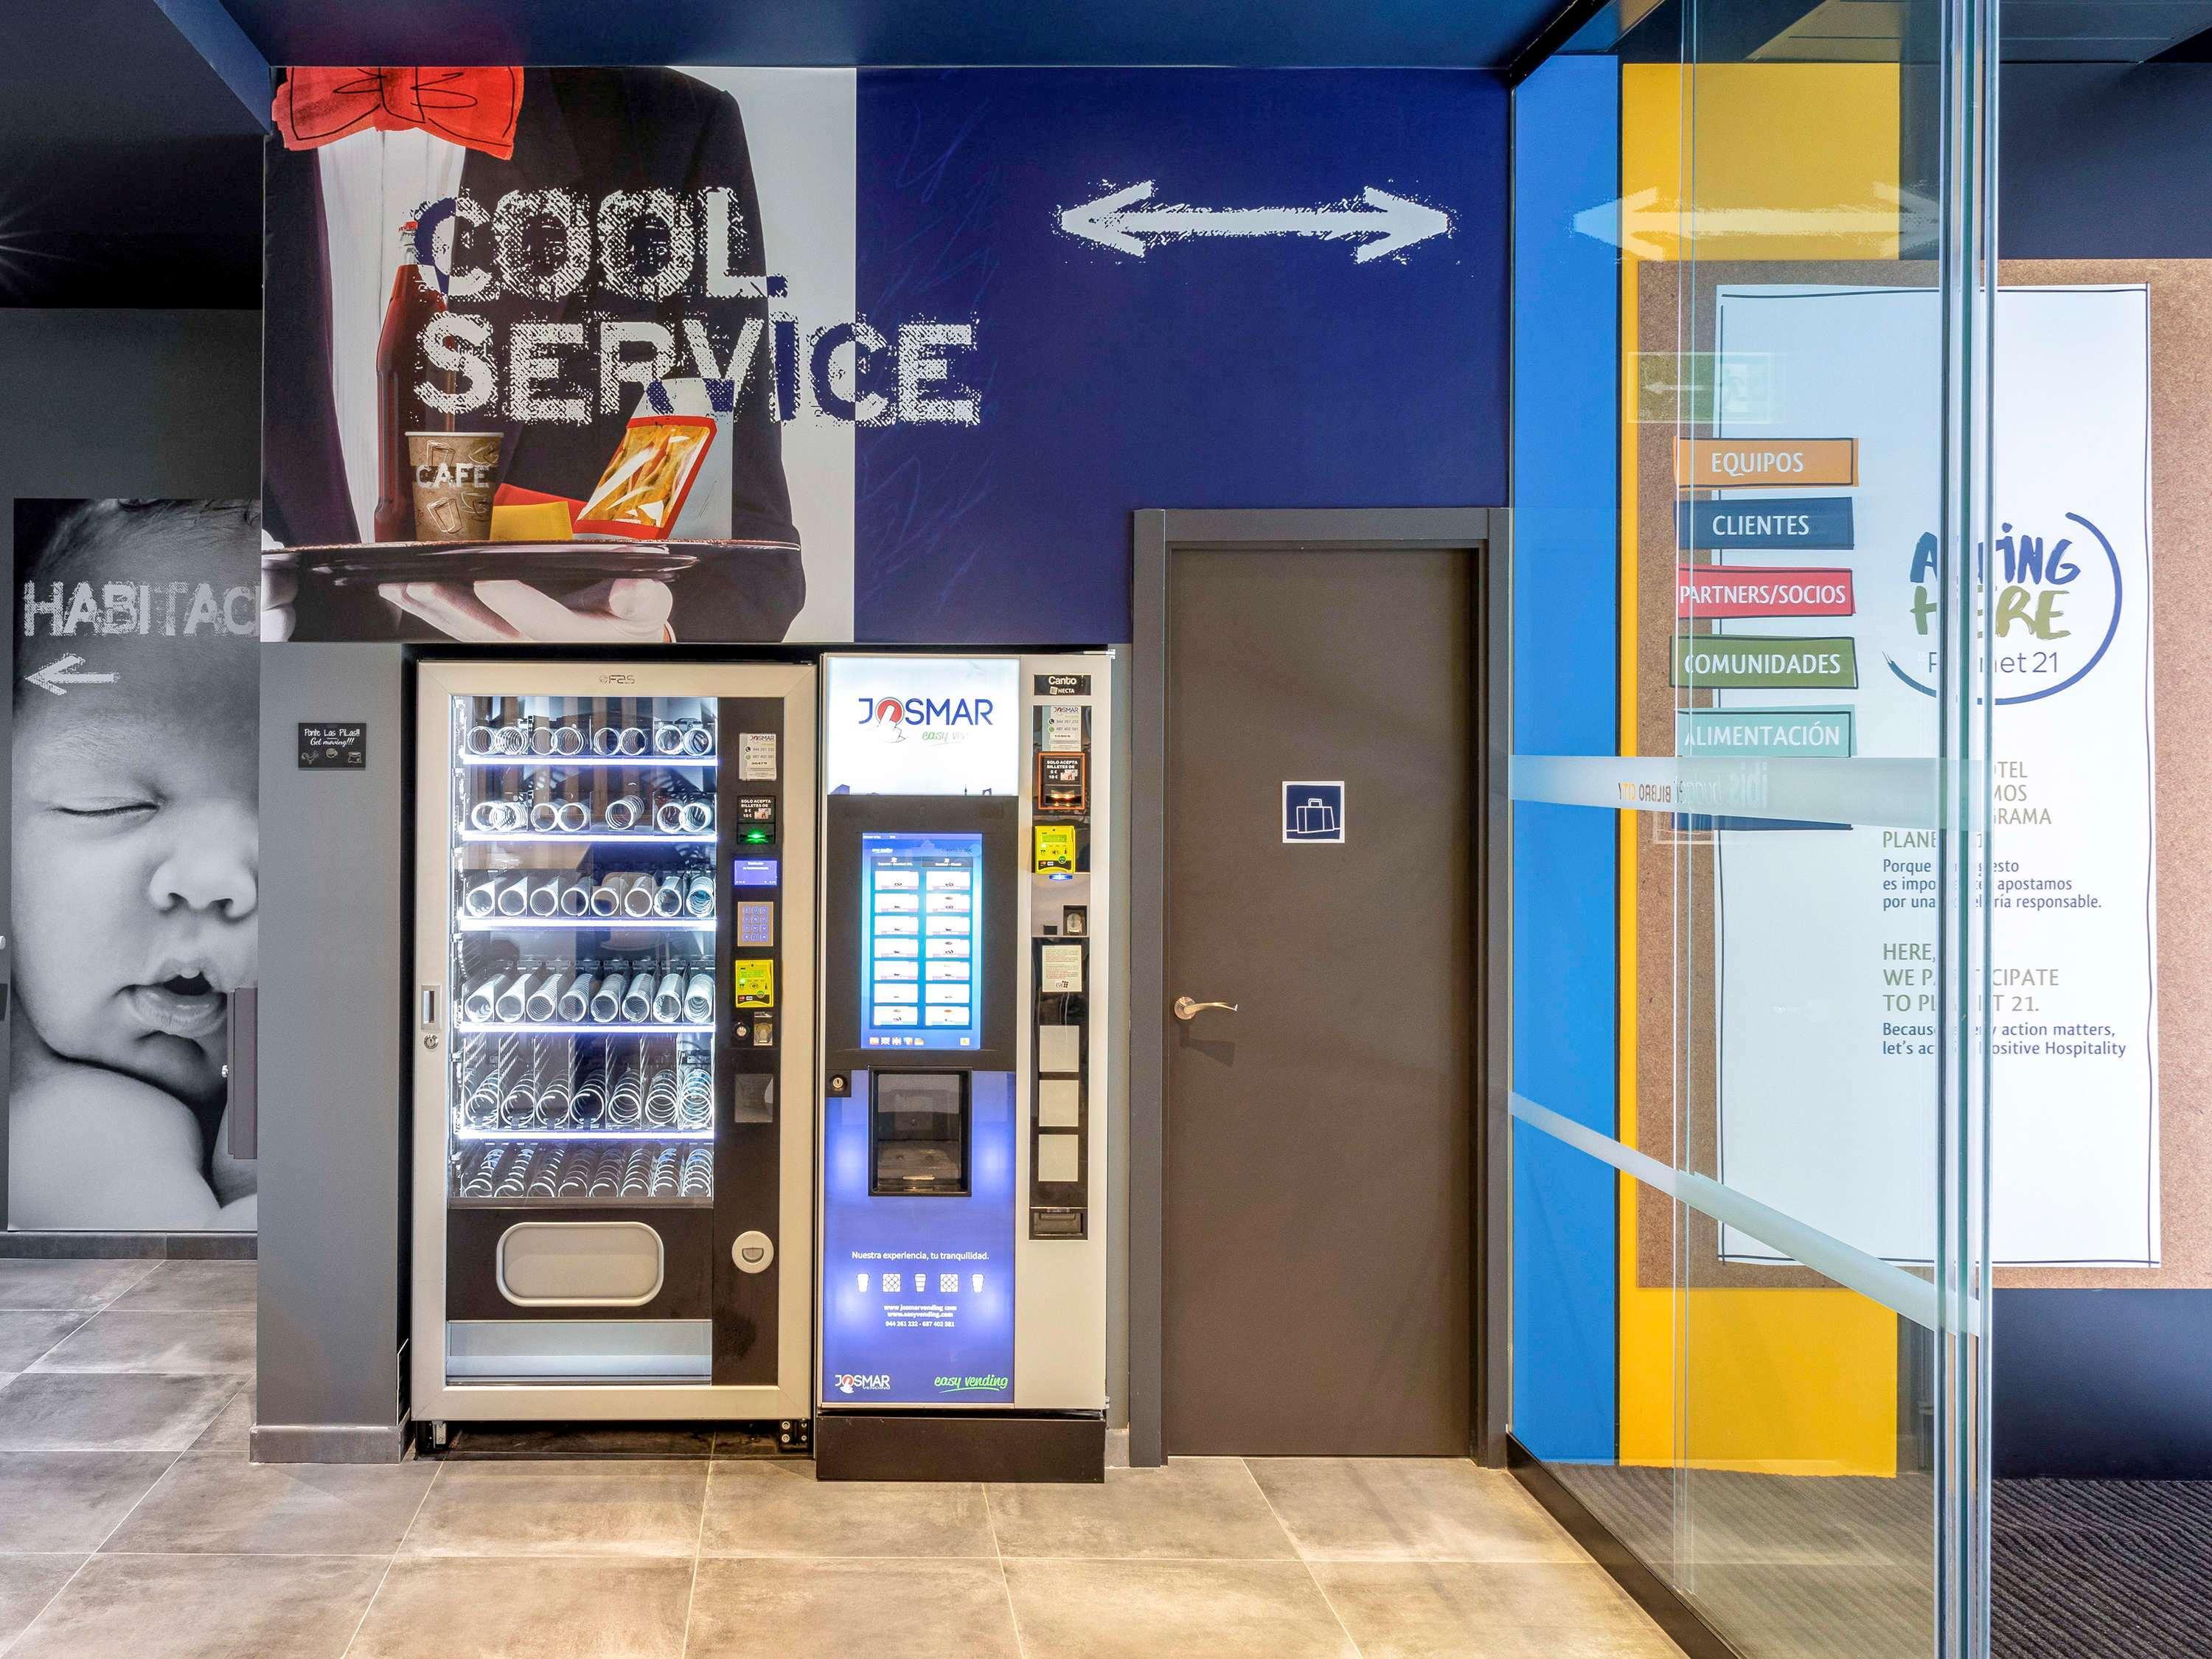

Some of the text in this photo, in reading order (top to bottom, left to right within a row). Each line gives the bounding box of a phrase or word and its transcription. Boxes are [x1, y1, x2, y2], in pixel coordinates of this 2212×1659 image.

[410, 187, 789, 299] COOL
[414, 313, 981, 425] SERVICE
[1711, 452, 1804, 476] EQUIPOS
[1712, 515, 1809, 536] CLIENTES
[1680, 585, 1846, 605] PARTNERS/SOCIOS
[1910, 585, 2071, 640] HRE
[1684, 653, 1841, 675] COMUNIDADES
[2032, 651, 2058, 673] 21
[1048, 675, 1077, 685] Canto
[1684, 721, 1840, 746] ALIMENTACIÓN
[1994, 762, 2028, 778] TEL
[1882, 831, 1936, 848] PLANE
[1883, 859, 1932, 876] Porque
[1882, 880, 1898, 891] es
[1997, 877, 2073, 894] apostamos
[1883, 897, 1907, 911] por
[1911, 897, 1935, 908] una
[2017, 894, 2102, 911] responsable.
[1883, 943, 1935, 963] HERE,
[1883, 969, 1915, 986] WE
[1883, 995, 1912, 1012] TO
[2011, 995, 2039, 1012] 21.
[1883, 1023, 1935, 1035] Becaus
[2002, 1022, 2048, 1036] action
[2053, 1023, 2115, 1037] matters,
[2045, 1040, 2126, 1058] Hospitality
[852, 1251, 882, 1259] Nuestra
[883, 1251, 929, 1261] experiencia,
[940, 1251, 990, 1260] tranquilidad.
[835, 1374, 891, 1387] JOSMAR
[933, 1374, 1009, 1389] easy vending
